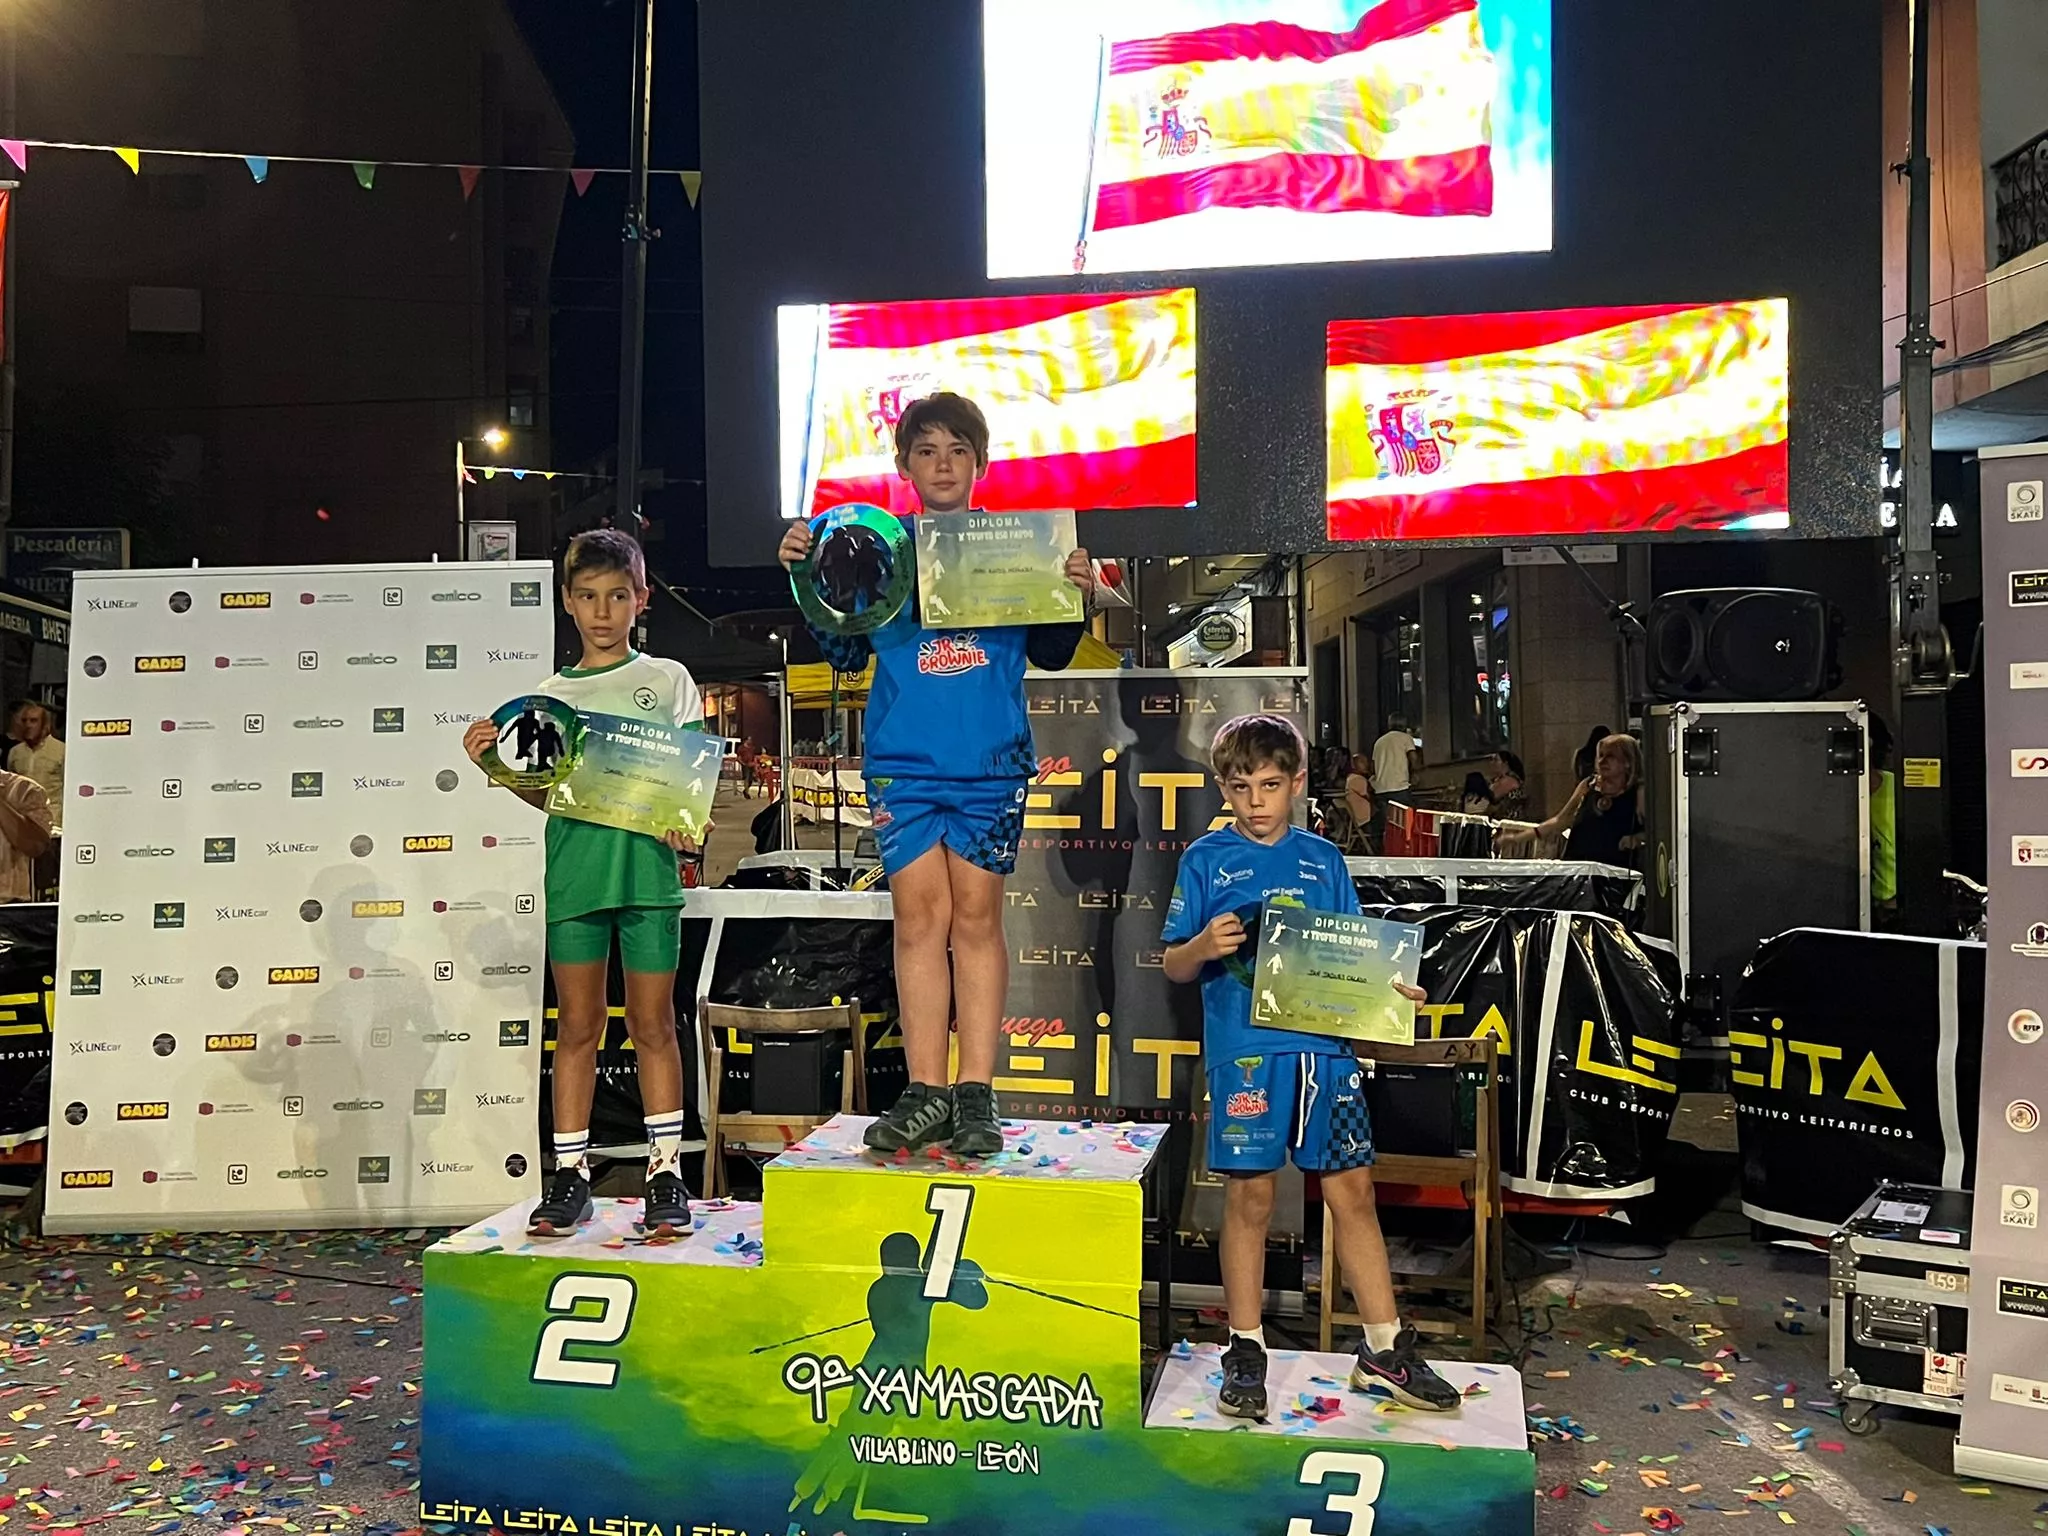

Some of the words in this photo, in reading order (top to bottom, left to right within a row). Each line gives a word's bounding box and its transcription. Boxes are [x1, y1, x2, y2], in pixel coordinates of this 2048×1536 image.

[968, 517, 1021, 529] DIPLOMA
[2010, 511, 2040, 520] SKATE
[223, 594, 269, 607] GADIS
[137, 658, 184, 671] GADIS
[919, 650, 986, 672] BROWNIE
[84, 721, 130, 734] GADIS
[620, 722, 672, 741] DIPLOMA
[405, 837, 451, 850] GADIS
[1020, 838, 1133, 851] DEPORTIVO
[354, 902, 404, 916] GADIS
[1315, 917, 1369, 934] DIPLOMA
[271, 968, 319, 983] GADIS
[207, 1035, 255, 1050] GADIS
[1569, 1088, 1609, 1105] CLUB
[119, 1104, 167, 1118] GADIS
[1010, 1102, 1127, 1118] DEPORTIVO
[1800, 1114, 1914, 1139] LEITARIEGOS
[64, 1172, 112, 1186] GADIS
[2003, 1214, 2035, 1226] SKATE
[923, 1187, 973, 1298] 1
[532, 1275, 634, 1386] 2
[856, 1365, 1100, 1428] XAMASCADA
[1287, 1451, 1385, 1536] 3
